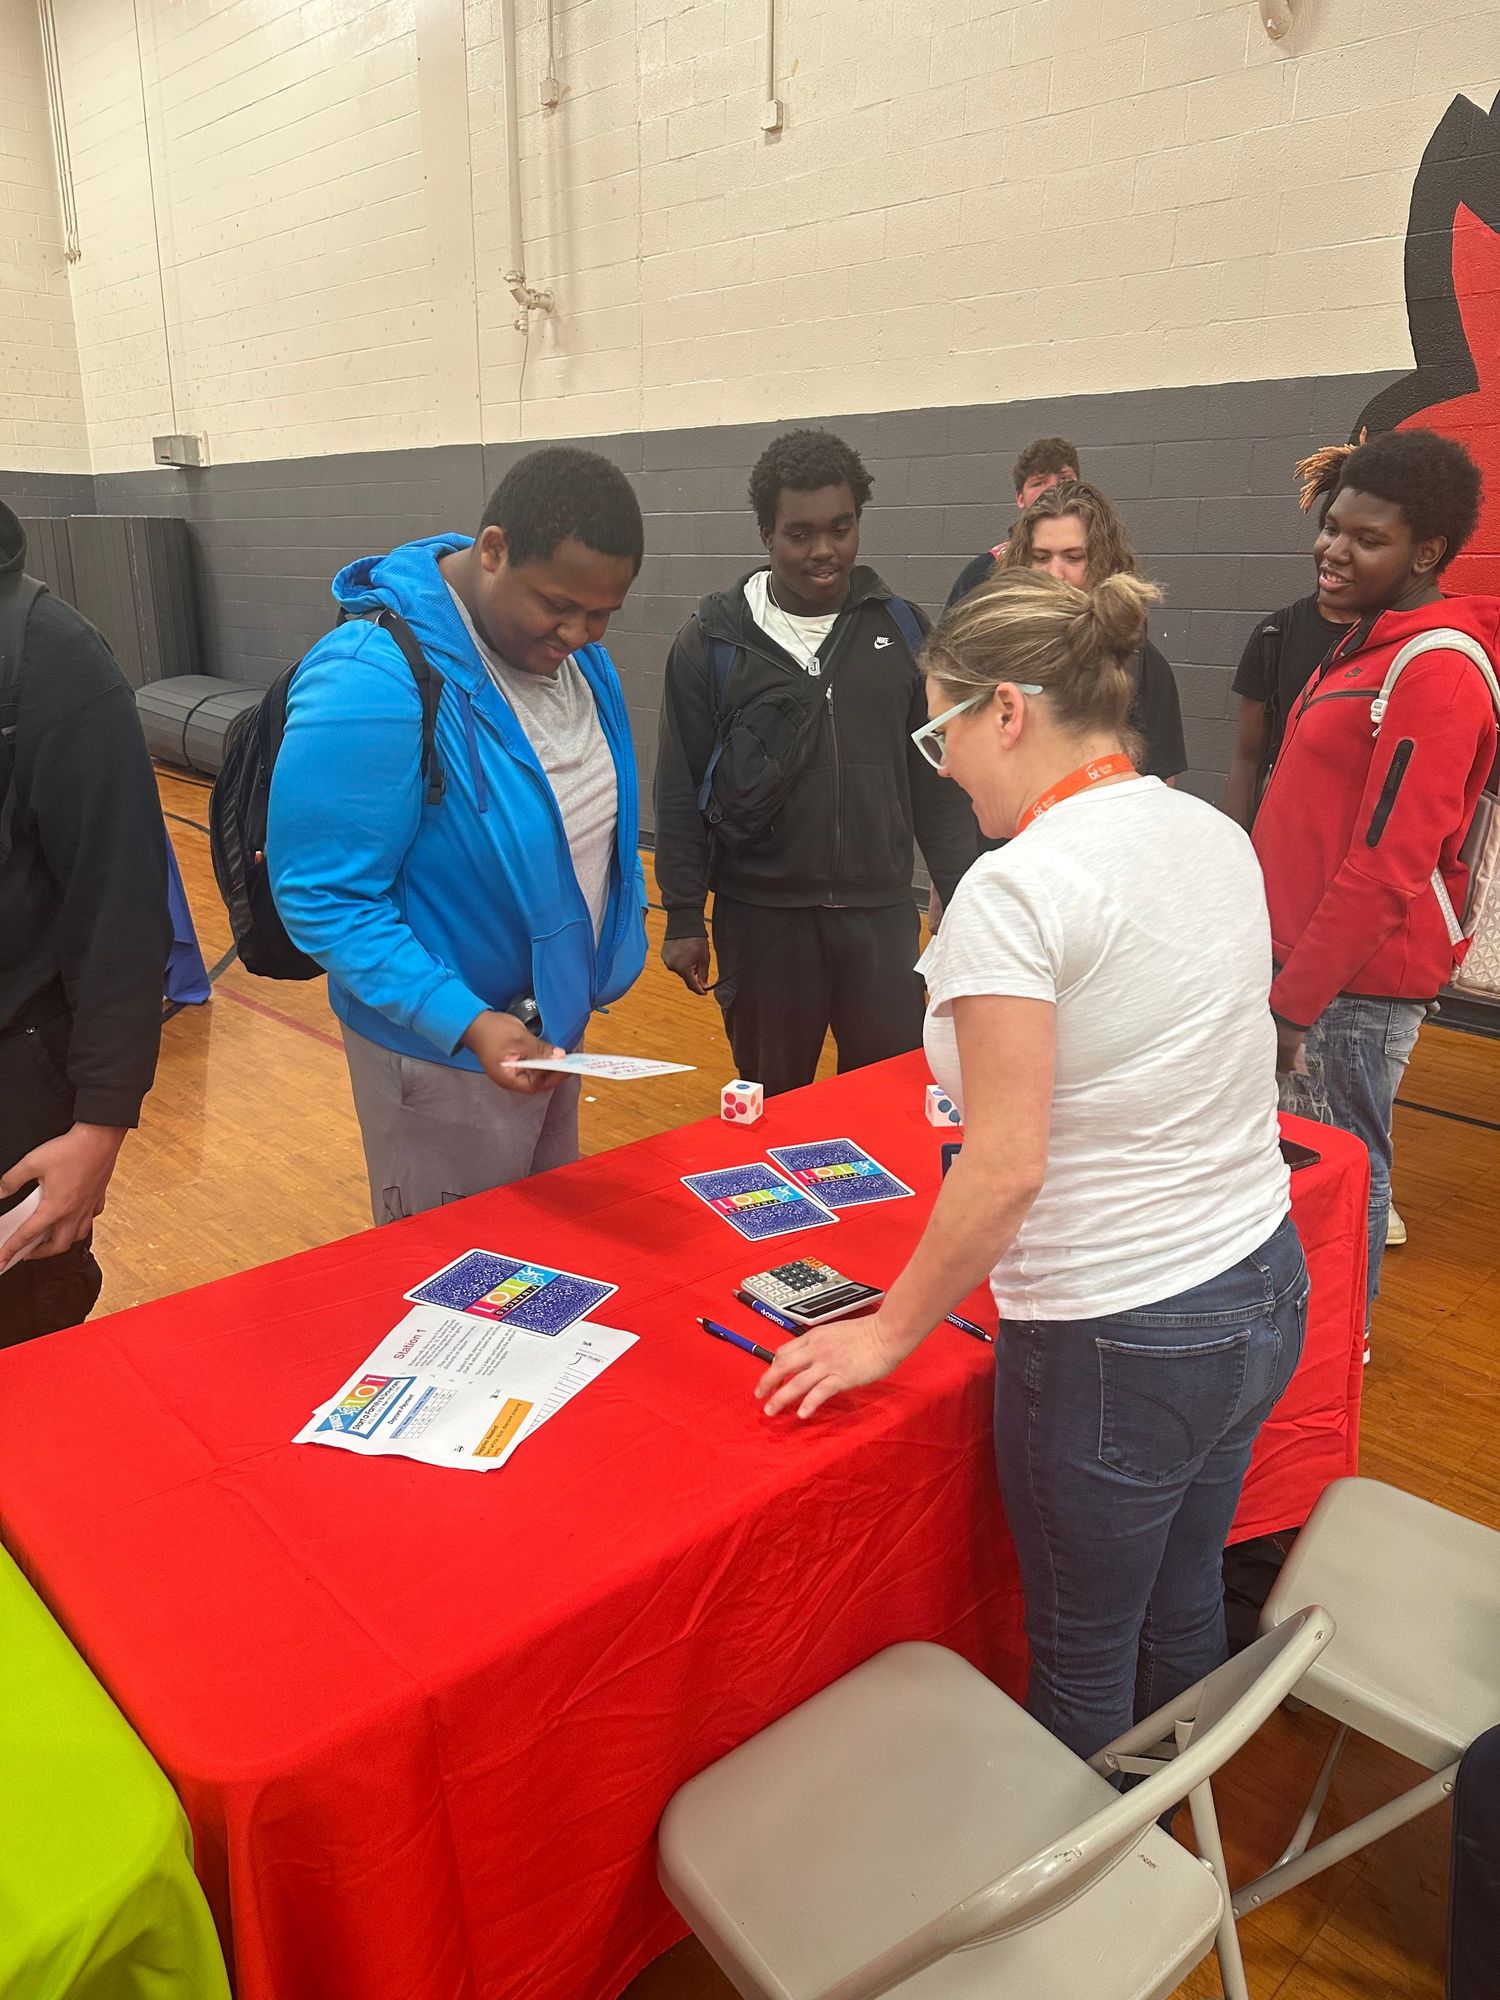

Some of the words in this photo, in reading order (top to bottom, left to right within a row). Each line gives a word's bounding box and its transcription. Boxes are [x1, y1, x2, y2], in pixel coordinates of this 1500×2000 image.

[800, 1166, 849, 1181] 101
[716, 1191, 771, 1209] 101
[472, 1283, 525, 1314] 101
[393, 1334, 423, 1360] Station
[345, 1377, 388, 1405] 101
[398, 1393, 415, 1410] Payment
